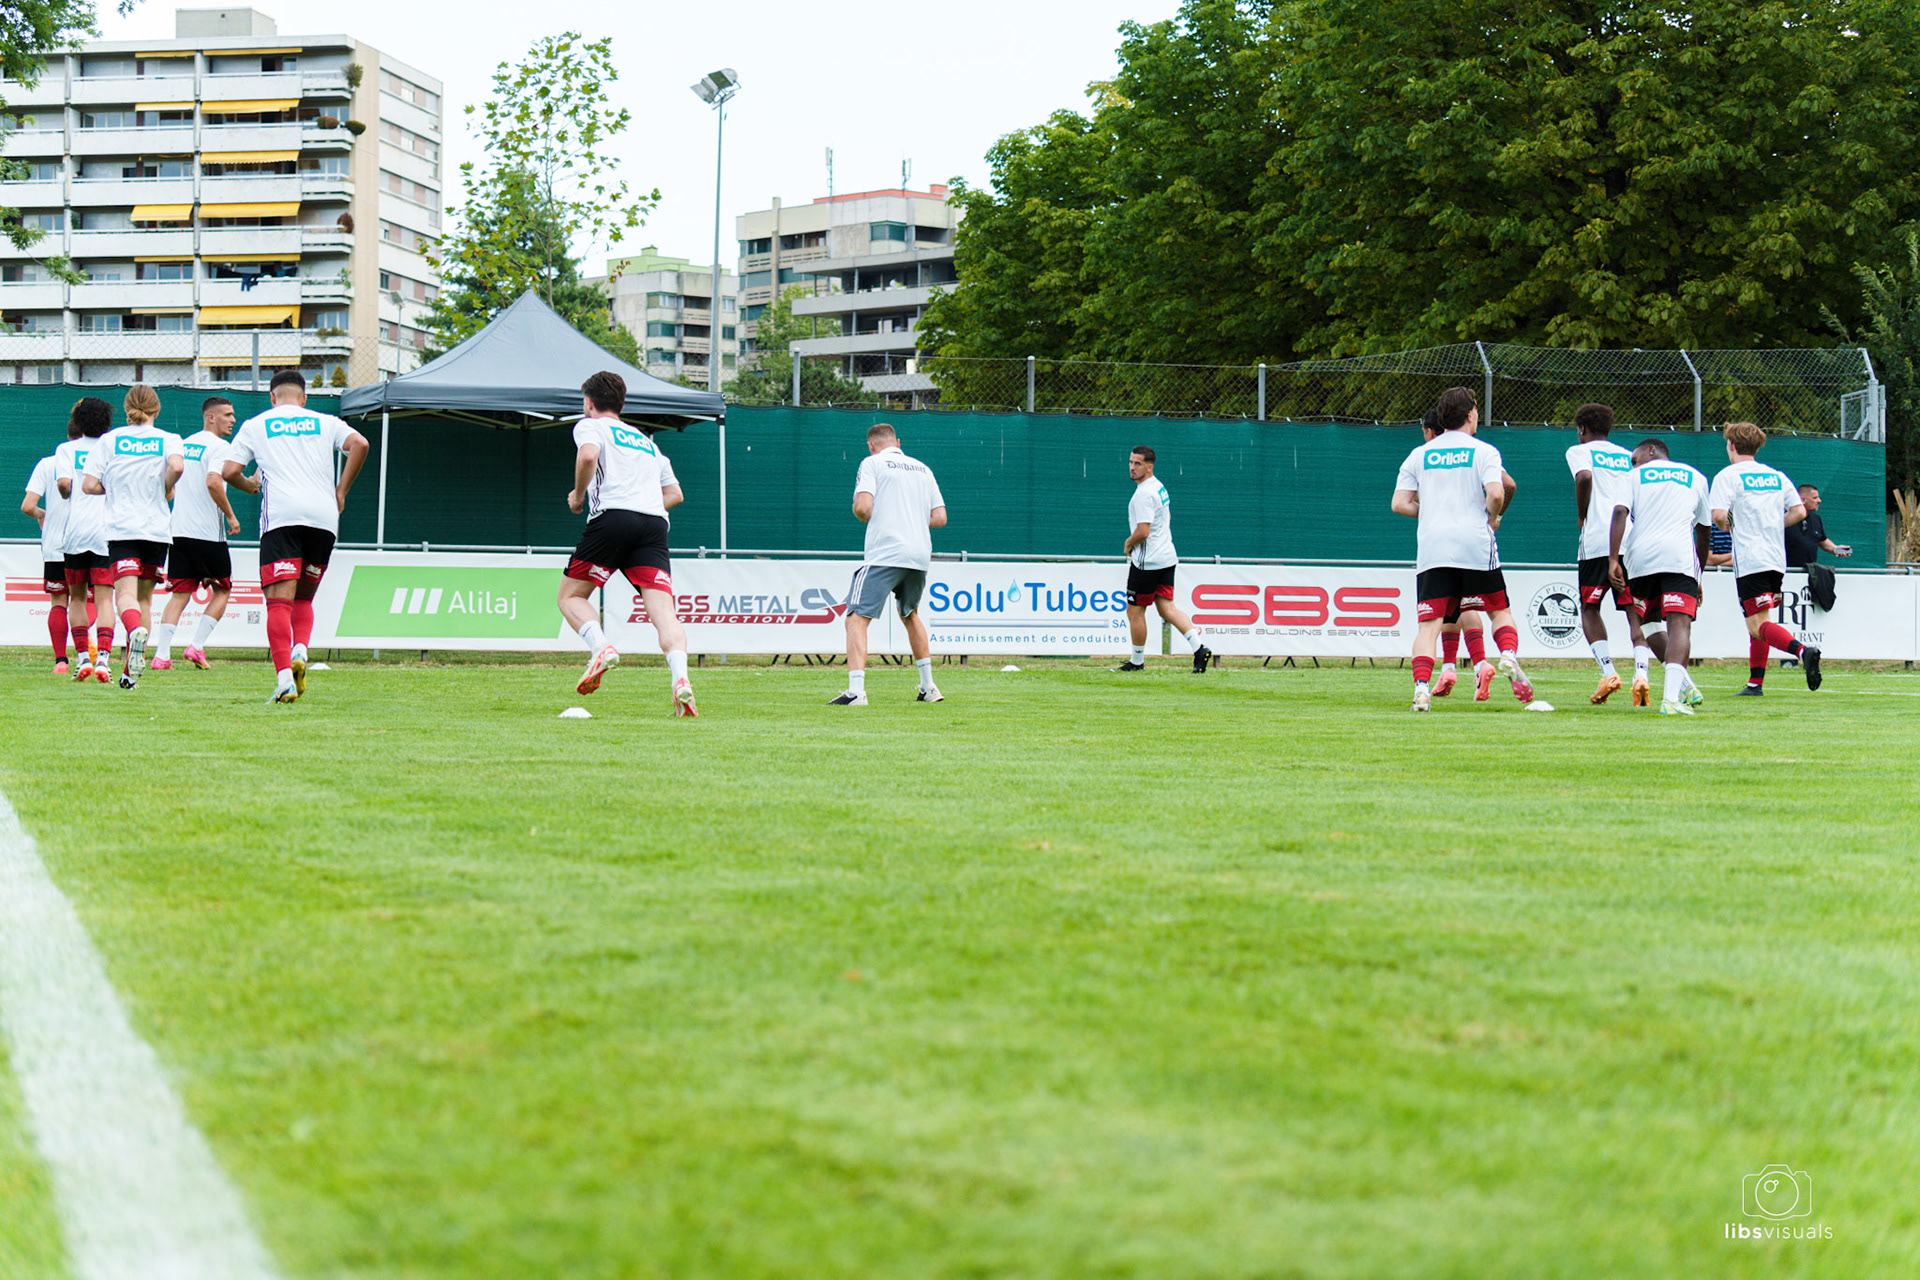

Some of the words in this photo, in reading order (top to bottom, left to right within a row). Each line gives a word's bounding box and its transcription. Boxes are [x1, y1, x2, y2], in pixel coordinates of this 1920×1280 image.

[632, 594, 710, 613] SISS
[717, 594, 798, 613] METAL
[929, 582, 1004, 613] Solu
[1023, 582, 1127, 613] Tubes
[447, 590, 517, 620] Alilaj
[1191, 584, 1401, 627] SBS
[635, 615, 789, 624] CSTRUCTION
[1112, 620, 1127, 628] SA
[930, 633, 1036, 643] Assainissement
[1041, 634, 1056, 643] de
[1063, 634, 1127, 643] conduites
[1205, 627, 1250, 635] SWISS
[1255, 628, 1322, 636] BUILDING
[1327, 629, 1401, 637] SERVICES
